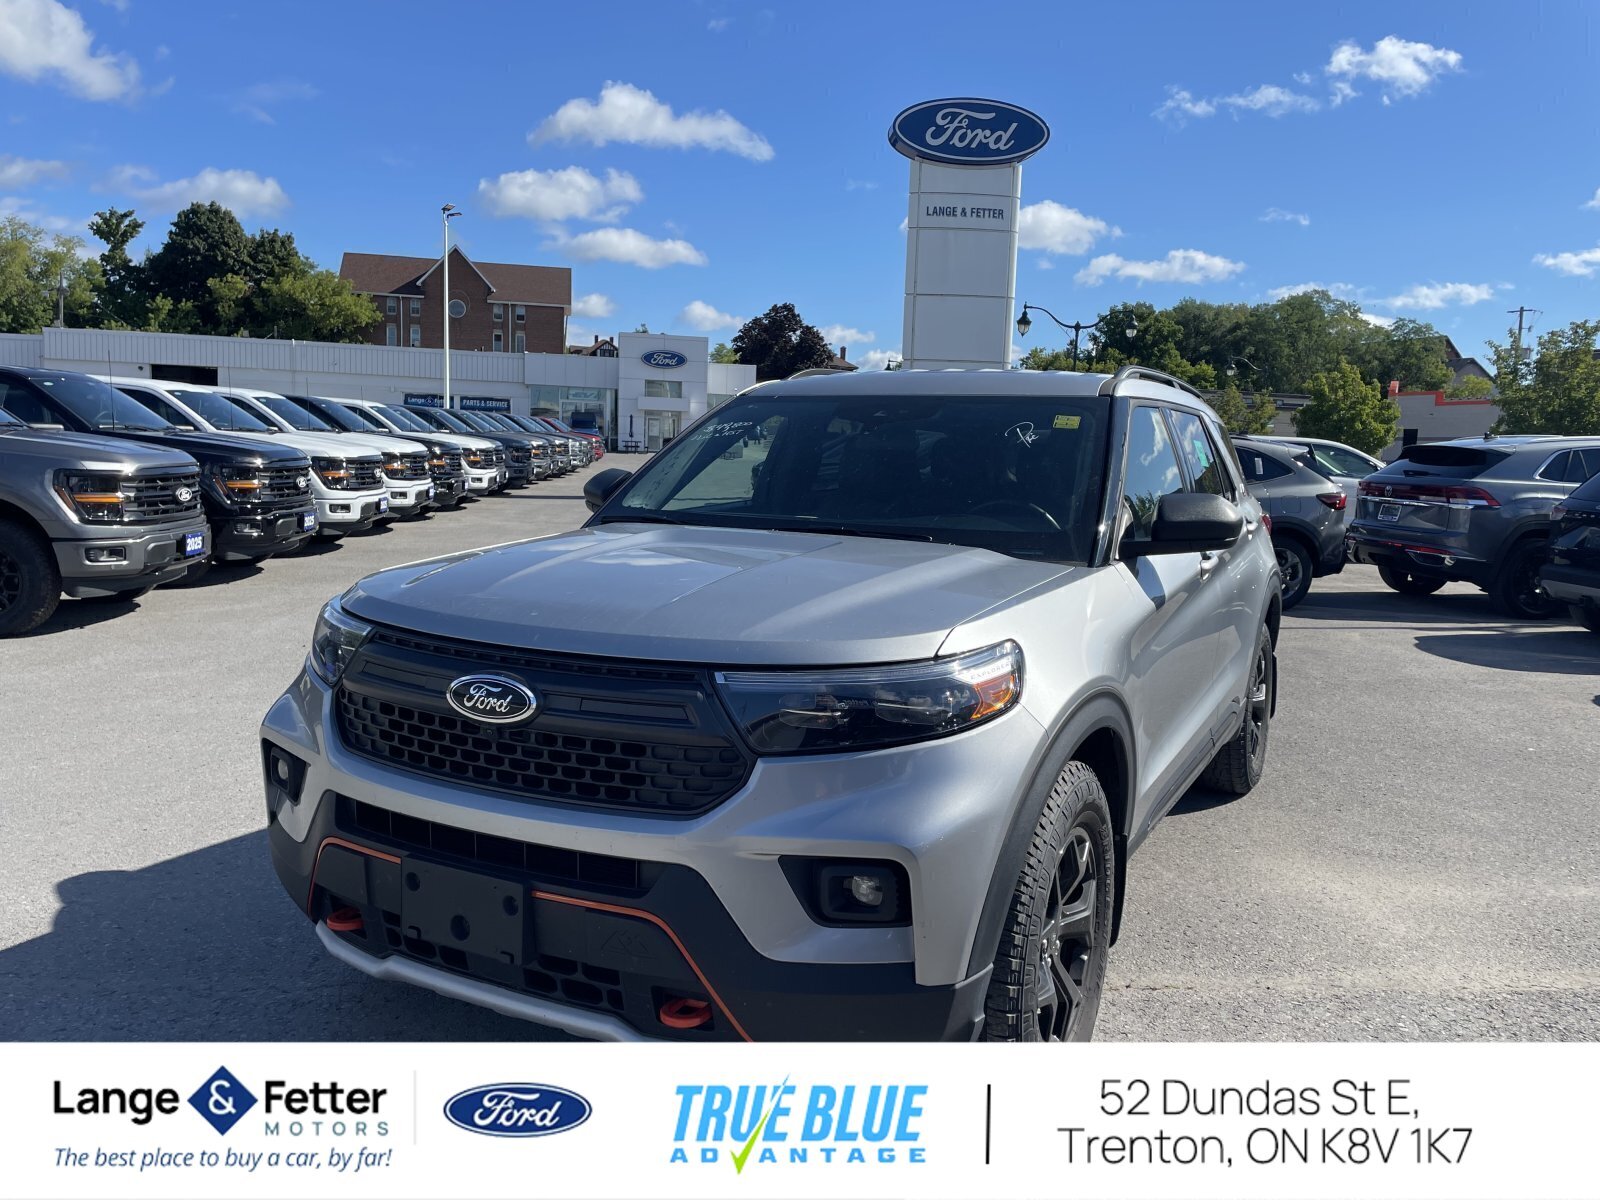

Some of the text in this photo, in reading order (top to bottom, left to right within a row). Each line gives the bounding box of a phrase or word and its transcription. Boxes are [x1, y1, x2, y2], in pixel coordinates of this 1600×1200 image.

[926, 108, 1018, 150] Ford
[926, 206, 1004, 220] LANGE & FETTER
[651, 353, 678, 365] Ford
[462, 399, 480, 407] PARTS
[487, 400, 508, 408] SERVICE
[187, 536, 202, 551] 2025
[464, 683, 513, 713] Ford
